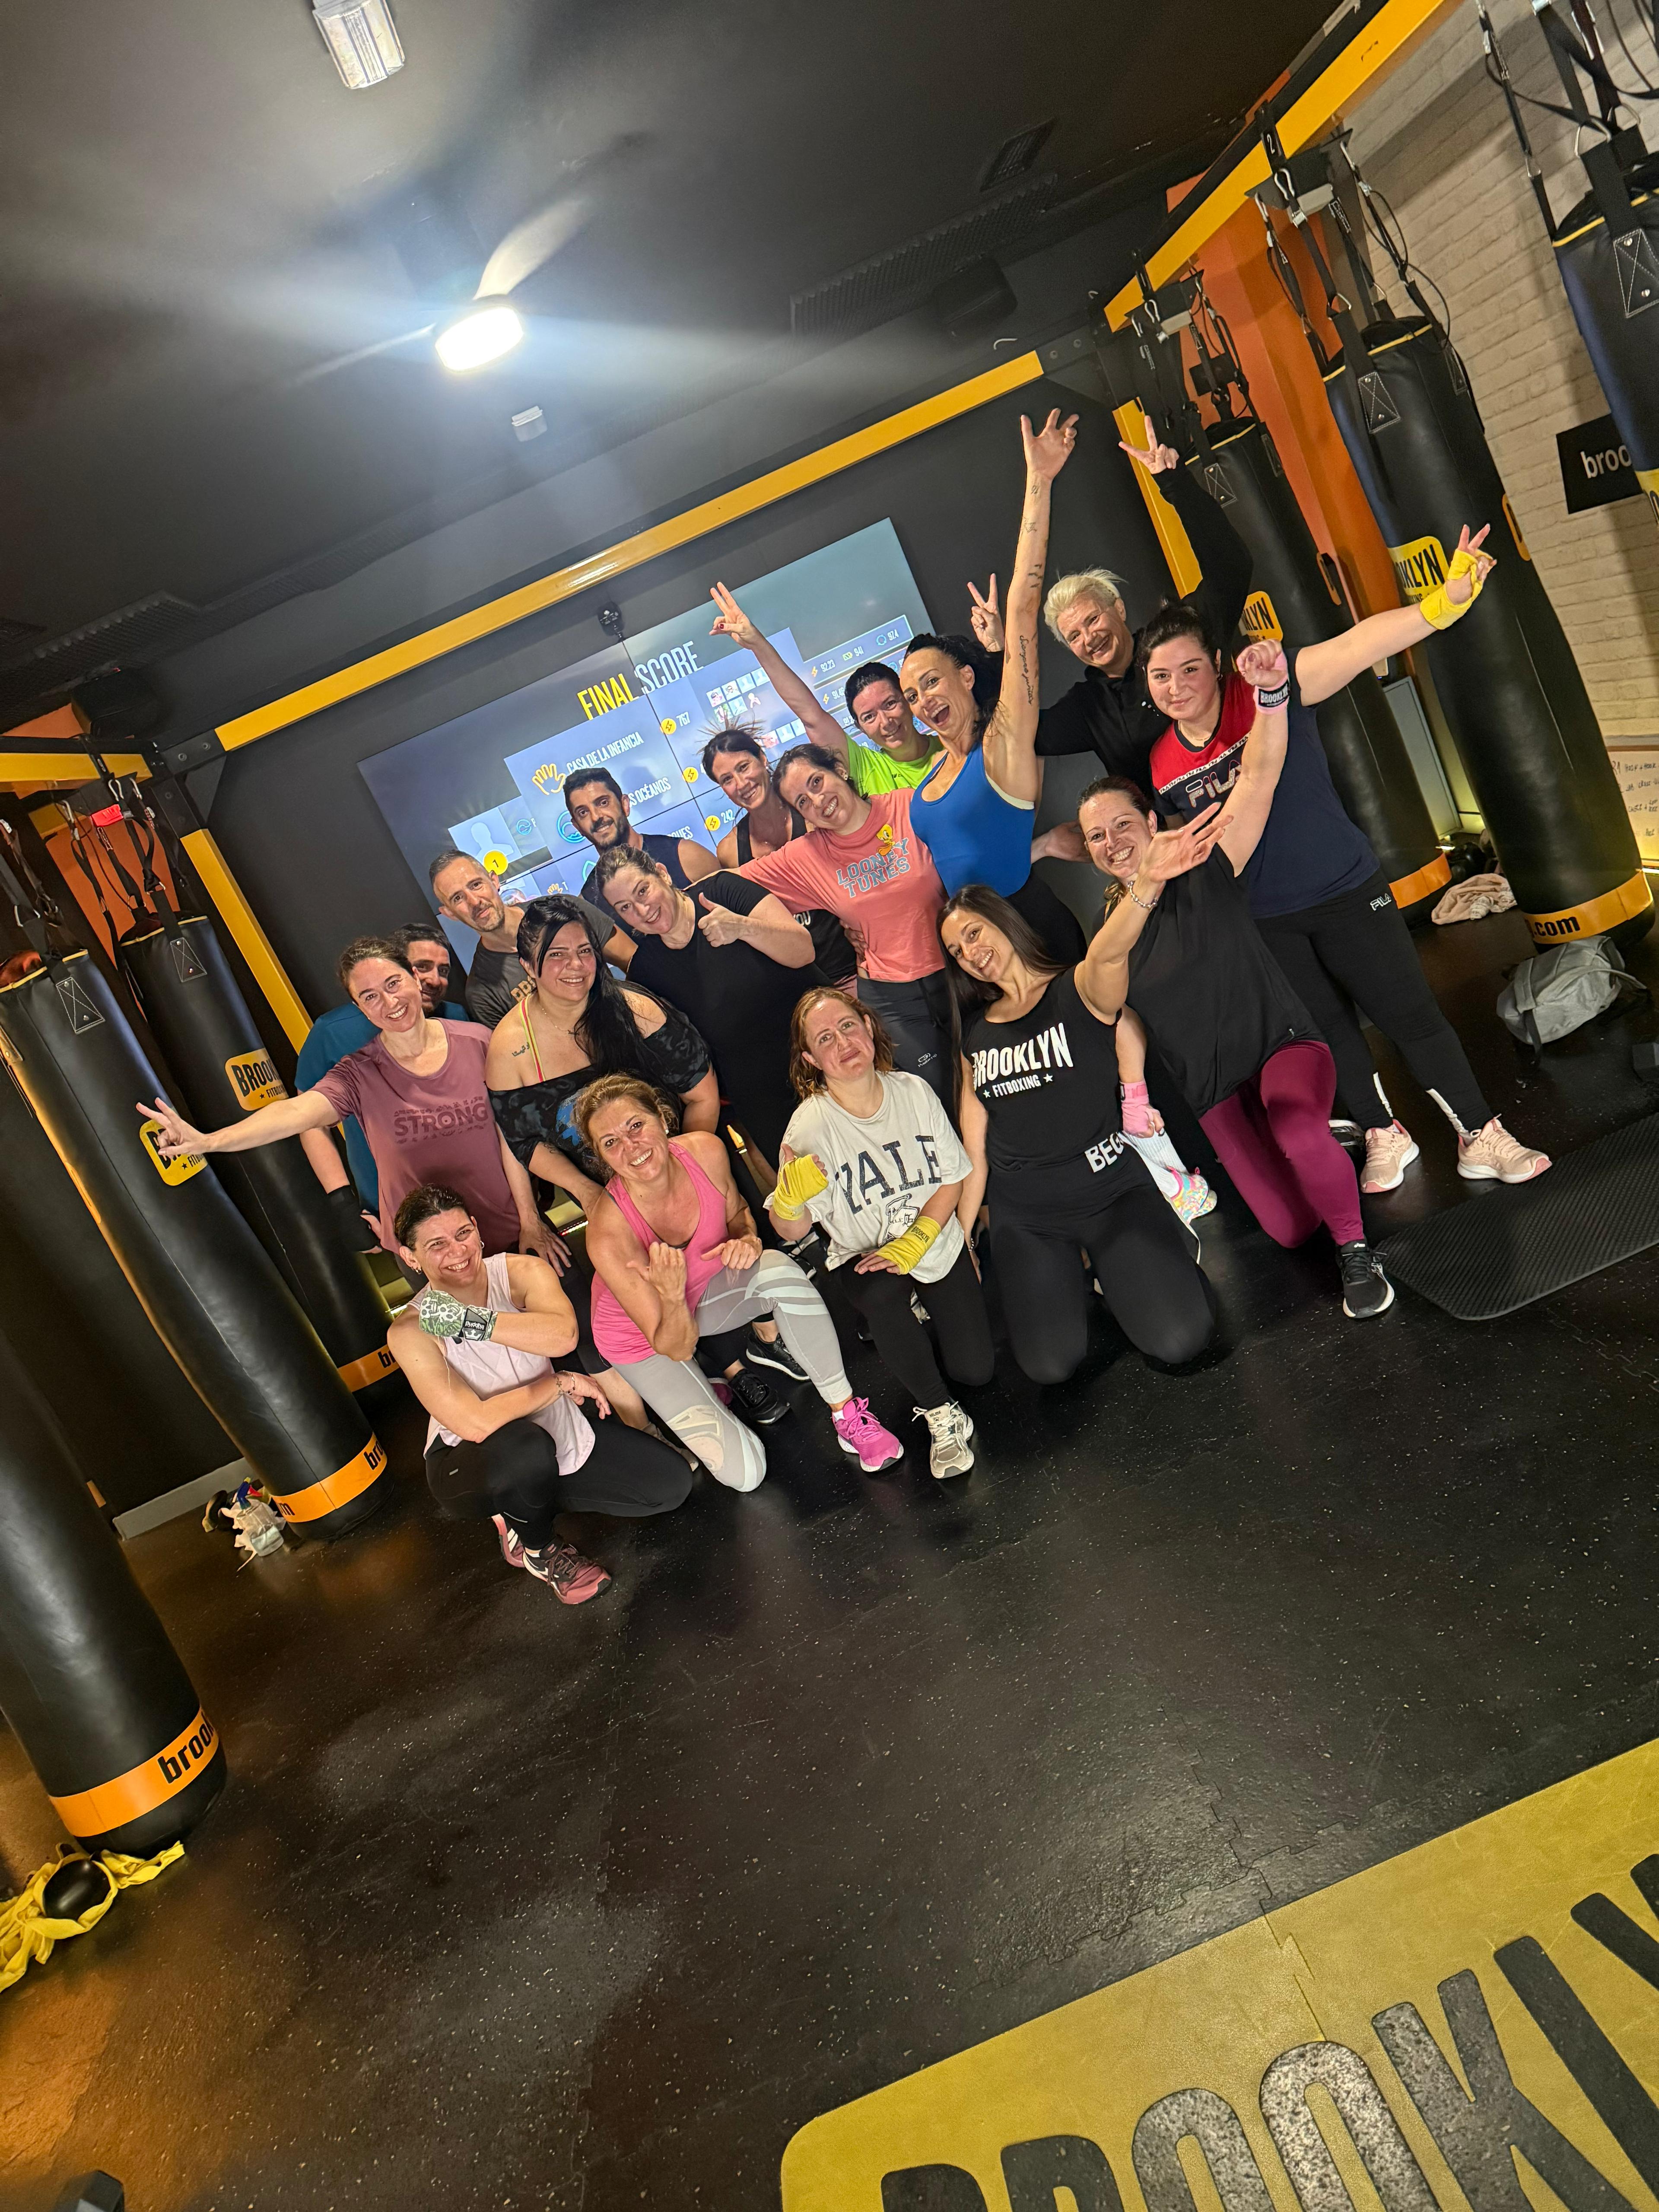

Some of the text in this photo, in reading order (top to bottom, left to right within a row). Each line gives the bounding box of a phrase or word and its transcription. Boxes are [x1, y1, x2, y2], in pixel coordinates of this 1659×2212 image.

[1267, 133, 1275, 154] 2
[577, 641, 704, 720] FINAL SCORE
[676, 712, 690, 727] 767
[566, 731, 645, 773] CASA DE LA INFANCIA
[635, 777, 671, 804] OCÉANOS
[1185, 759, 1241, 807] FILA
[721, 809, 735, 823] 242
[836, 837, 909, 886] LOONEY
[844, 857, 910, 898] TUNES
[1370, 893, 1392, 911] FILA
[971, 1022, 1074, 1092] BROOKLYN
[992, 1074, 1042, 1098] FITBOXING
[394, 1103, 489, 1136] STRONG
[835, 1135, 942, 1214] YALE
